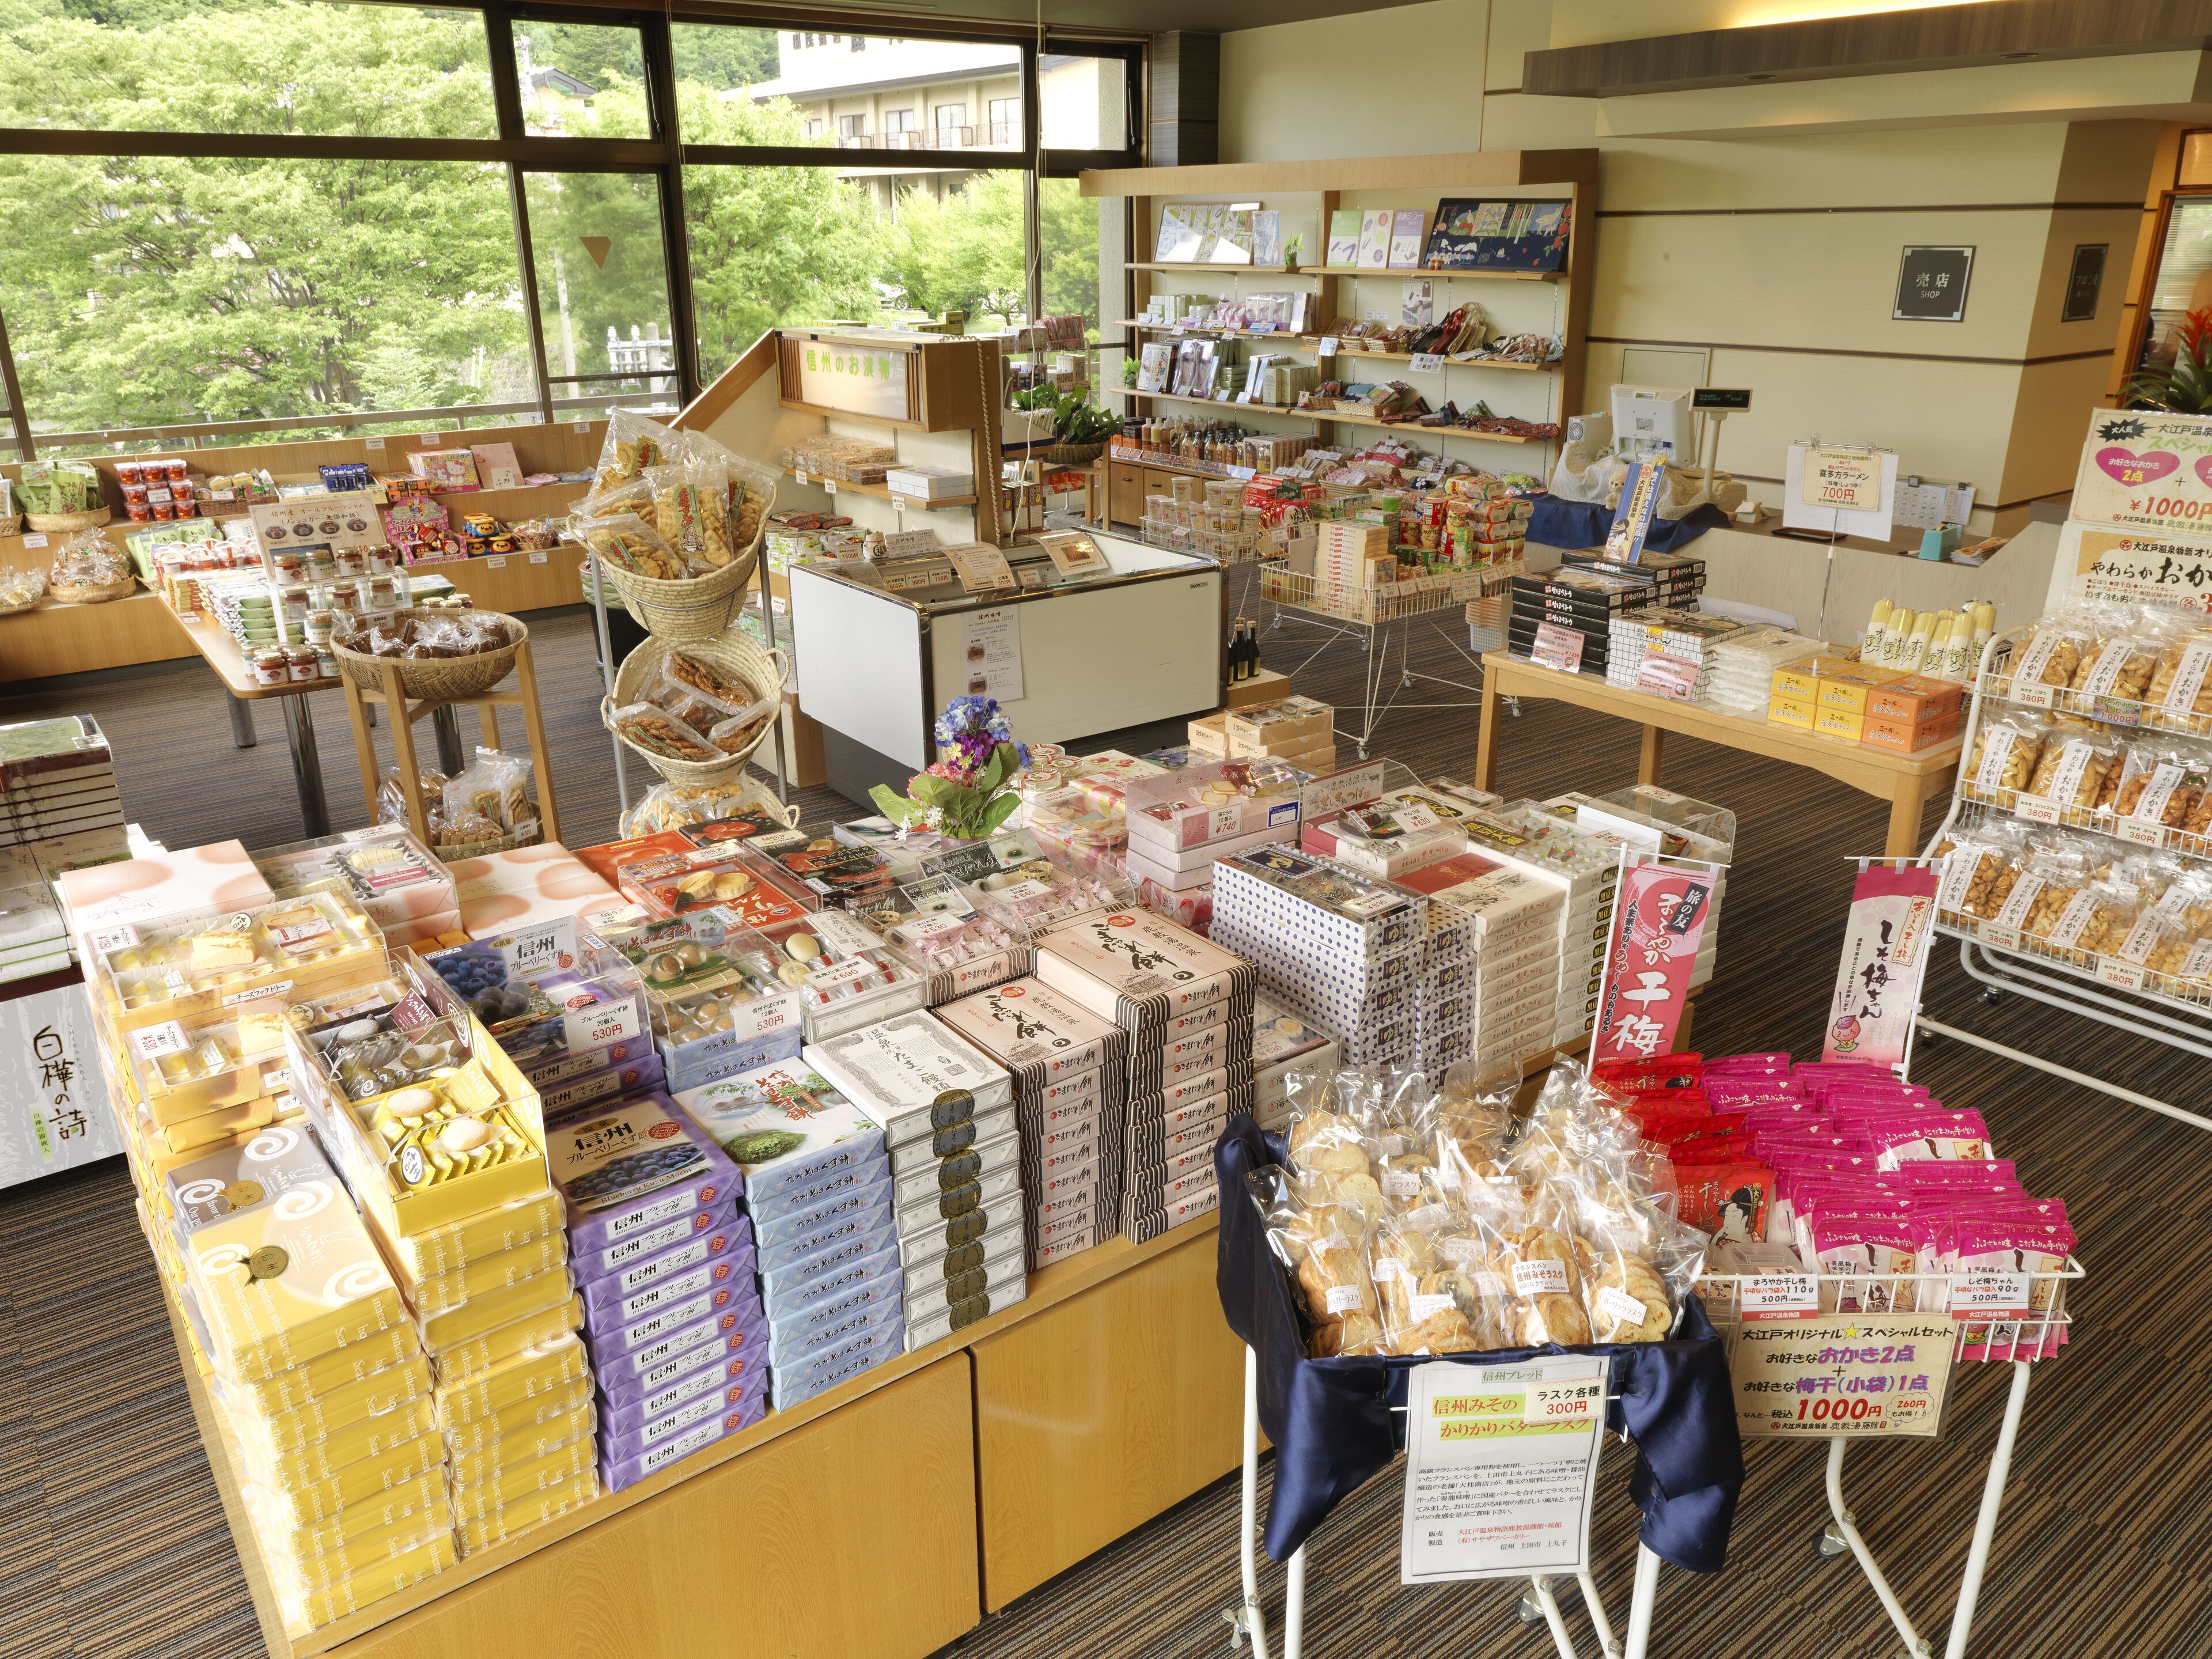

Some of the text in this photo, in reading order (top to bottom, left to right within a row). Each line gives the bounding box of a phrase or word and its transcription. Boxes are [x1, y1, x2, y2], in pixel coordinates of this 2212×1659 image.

[1916, 272, 1950, 287] 売店
[1921, 290, 1940, 298] SHOP
[806, 349, 891, 381] 信州のお漬物
[2111, 426, 2133, 434] 大人気
[2108, 457, 2160, 469] お好きなおかき
[1819, 469, 1870, 480] 喜多方ラーメン
[2122, 470, 2143, 482] 2点
[1823, 486, 1855, 501] 700円
[1218, 809, 1233, 817] 桜ひらら
[1215, 821, 1236, 834] ¥740
[1411, 817, 1430, 828] ¥630
[2129, 832, 2156, 844] 380円
[1367, 900, 1387, 915] ¥630
[1672, 888, 1701, 928] 旅の友
[922, 923, 948, 935] ¥530
[516, 935, 556, 959] 信州
[1988, 934, 2012, 947] 380円
[831, 968, 860, 982] ¥690
[1859, 919, 1897, 1019] しそ梅ちゃん
[2107, 972, 2134, 986] 380円
[236, 983, 285, 1002] チーズファクトリー
[752, 998, 787, 1014] 信州そばくず餅
[761, 1008, 779, 1017] 12個入
[1611, 970, 1672, 1053] 干梅
[581, 1005, 628, 1024] ブルーベリーくず餅
[597, 1017, 615, 1027] 20個入
[757, 1014, 785, 1031] 530円
[592, 1023, 623, 1041] 530円
[141, 1031, 158, 1051] ¥530
[33, 1024, 87, 1140] 白樺の詩
[67, 1023, 99, 1127] SHIRAKABA no UTA
[33, 1112, 50, 1153] 白樺の樹液入
[573, 1122, 634, 1152] 信州
[600, 1166, 692, 1205] Blueberry Kuzu Mochi
[1972, 1237, 2069, 1252] ふるさとの味 こだわりの手作り
[1514, 1262, 1547, 1272] フランスパン
[1516, 1269, 1563, 1282] 信州みそラスク
[1753, 1277, 1806, 1286] まろやか干し梅
[1968, 1277, 2014, 1285] しそ梅ちゃん
[1761, 1295, 1788, 1303] 500円
[1759, 1310, 1801, 1319] 大江戸温泉物語
[1742, 1326, 1954, 1340] 大江戸オリジナル スペシャルセット
[1766, 1344, 1916, 1365] お好きなおかき2点
[1483, 1369, 1543, 1381] 信州ブレッド
[1537, 1385, 1601, 1401] ラスク各種
[1433, 1397, 1517, 1415] 信州みその
[1547, 1400, 1587, 1415] 300円
[1771, 1398, 1882, 1421] 税込 1000円
[1897, 1399, 1926, 1410] 260円
[647, 1444, 675, 1465] 信州
[1428, 1539, 1443, 1547] 製造
[1500, 1539, 1568, 1551] 信州 上田市 上丸子
